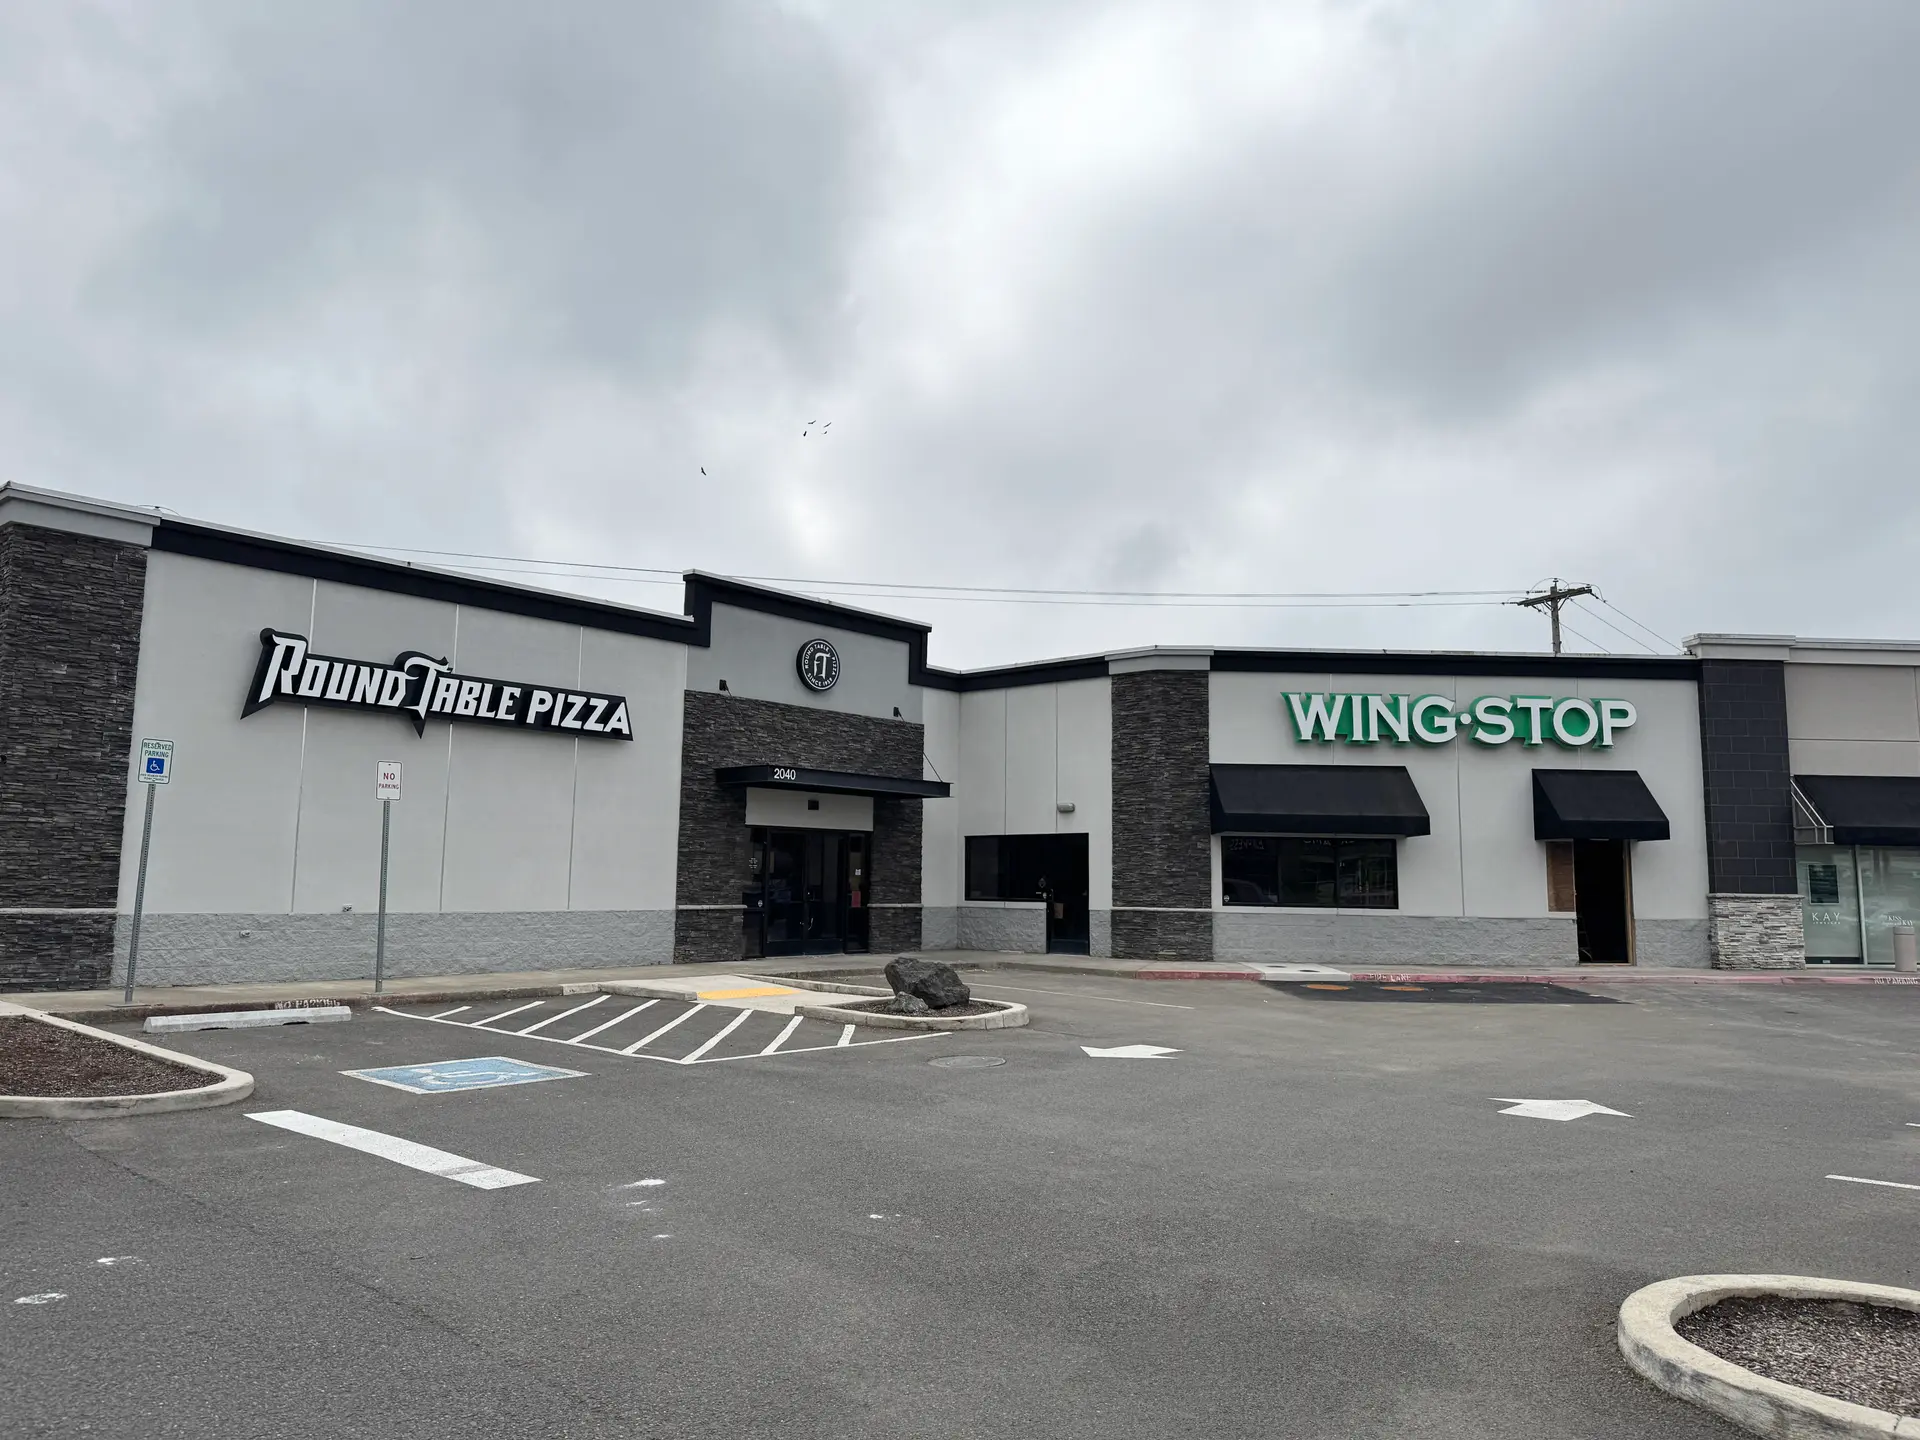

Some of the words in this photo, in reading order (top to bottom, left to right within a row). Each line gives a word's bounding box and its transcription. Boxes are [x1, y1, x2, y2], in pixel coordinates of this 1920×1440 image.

[804, 646, 814, 669] ROUND
[814, 643, 830, 652] TABLE
[259, 633, 409, 707] ROUND
[403, 656, 521, 720] TABLE
[525, 692, 631, 735] PIZZA
[807, 672, 822, 687] SINCE
[143, 741, 172, 751] RESERVED
[144, 750, 170, 758] PARKING
[383, 772, 396, 781] NO
[774, 768, 796, 780] 2040
[1812, 912, 1841, 921] KAY
[1873, 977, 1885, 985] NO
[1886, 977, 1919, 985] PARKING
[274, 1000, 291, 1010] NO
